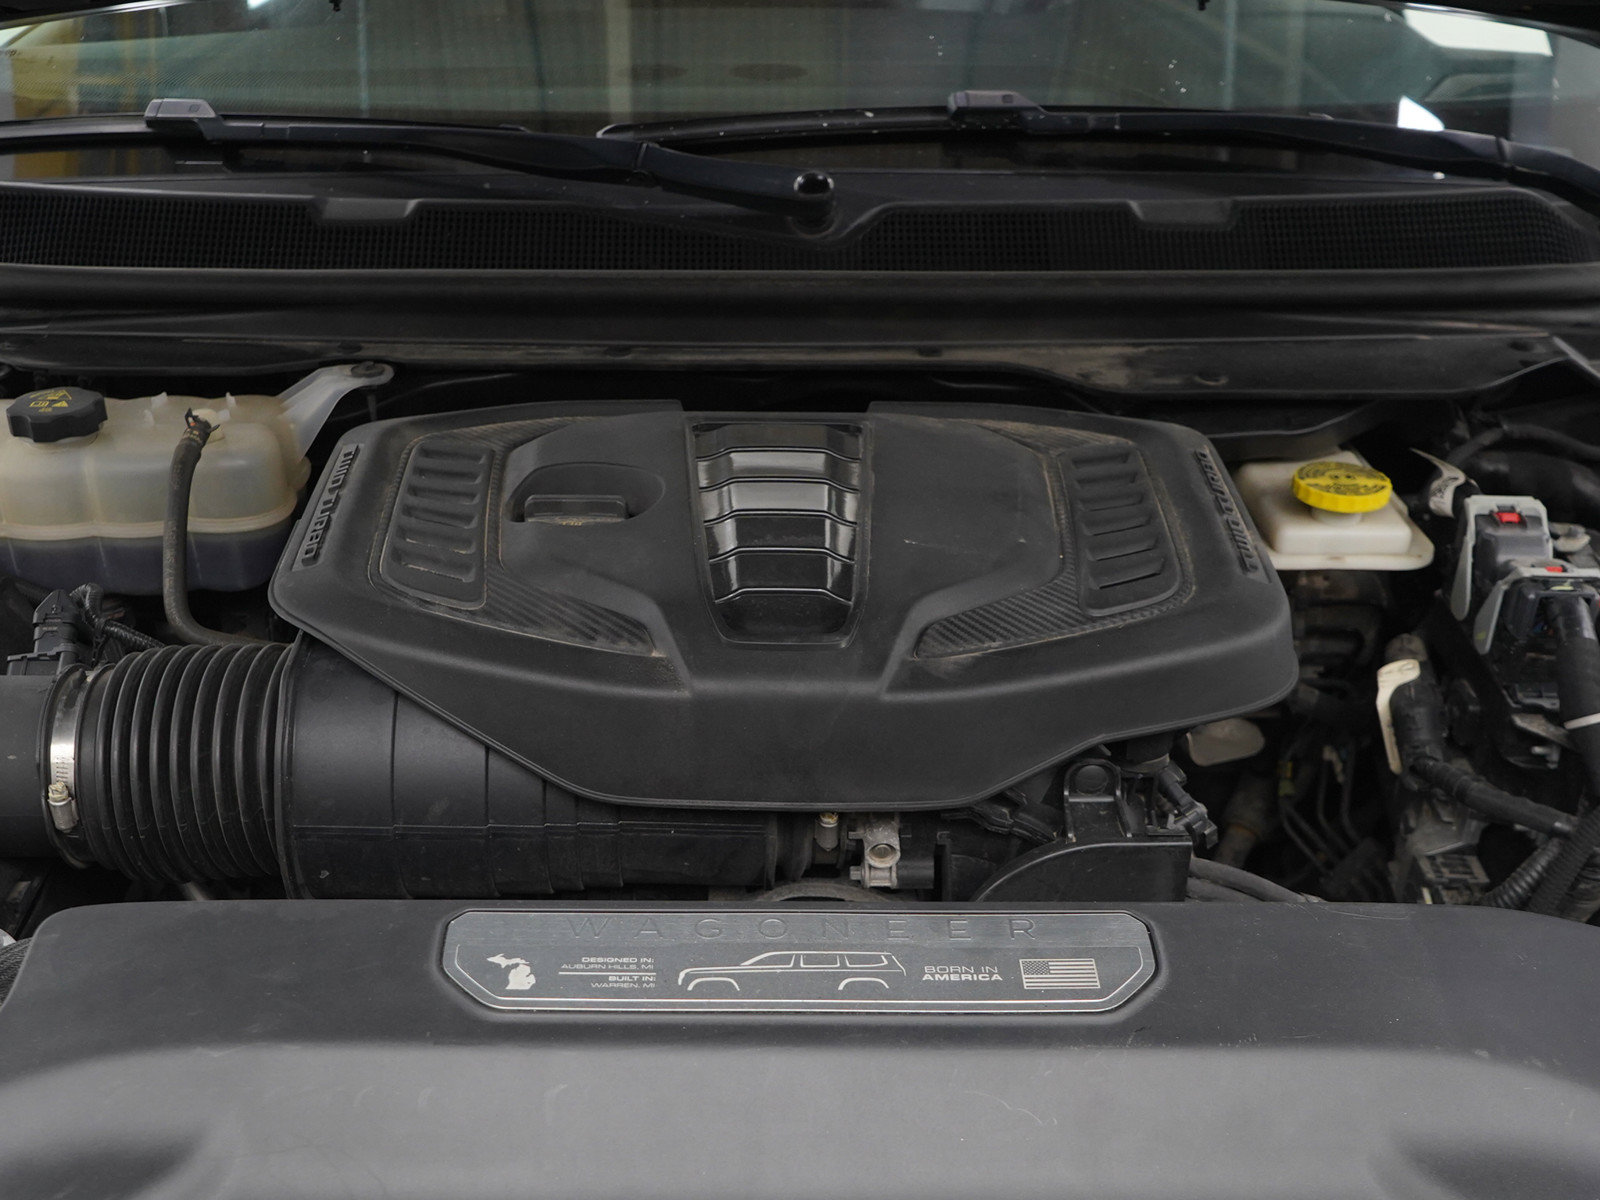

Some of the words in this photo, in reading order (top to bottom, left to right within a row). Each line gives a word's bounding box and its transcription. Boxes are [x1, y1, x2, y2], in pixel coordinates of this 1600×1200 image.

[566, 918, 1036, 940] WAGONEER
[581, 956, 638, 964] DESIGNED
[924, 965, 975, 974] BORN
[981, 966, 998, 974] IN
[922, 973, 1003, 981] AMERICA
